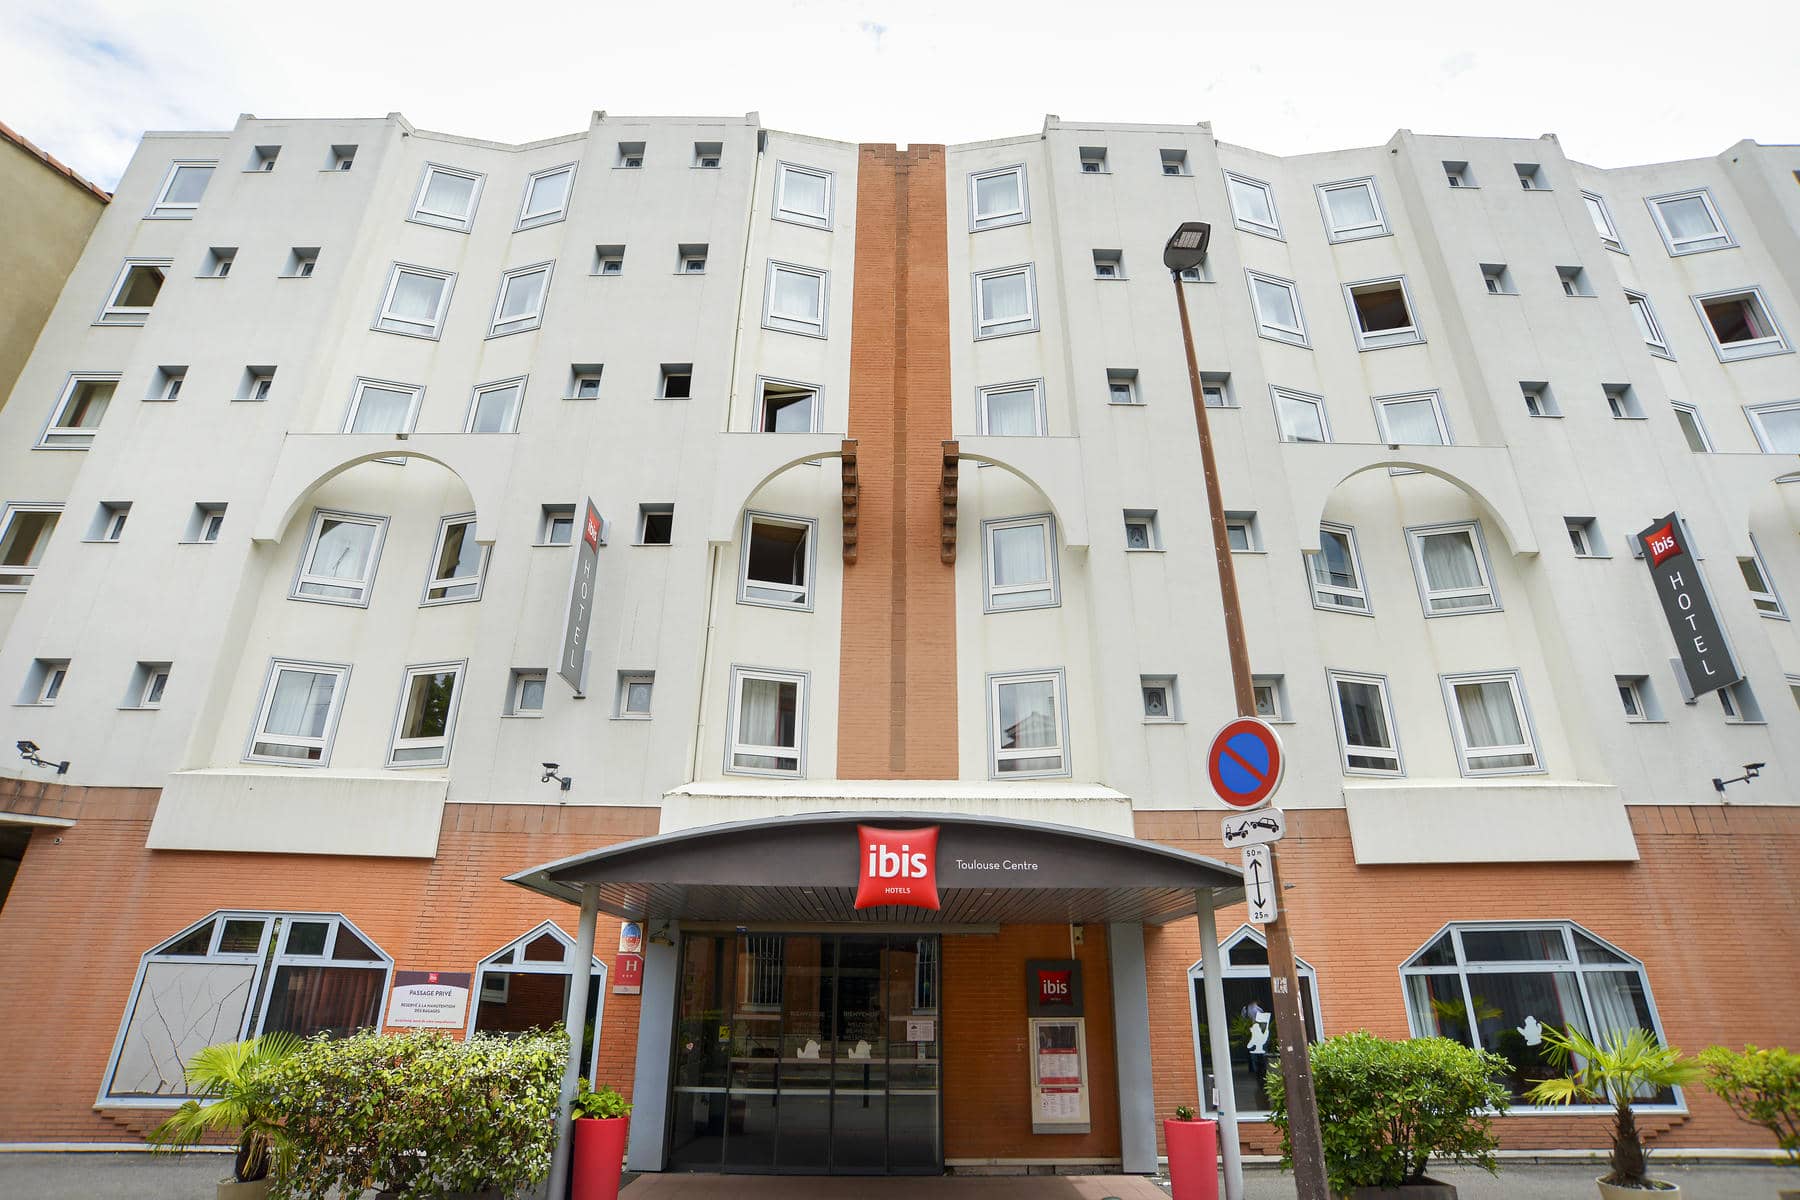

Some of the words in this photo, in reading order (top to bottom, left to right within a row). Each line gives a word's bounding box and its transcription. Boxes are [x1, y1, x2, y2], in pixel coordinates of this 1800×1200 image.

[587, 517, 598, 542] ibis
[1651, 535, 1675, 556] ibis
[570, 559, 591, 669] HOTEL
[1669, 571, 1716, 676] HOTEL
[868, 844, 928, 878] ibis
[956, 859, 1001, 870] Toulouse
[1002, 859, 1039, 871] Centre
[884, 887, 911, 895] HOTELS
[626, 960, 637, 972] H
[409, 989, 435, 997] PASSAGE
[435, 989, 452, 997] PRIVÉ
[1042, 979, 1068, 995] ibis
